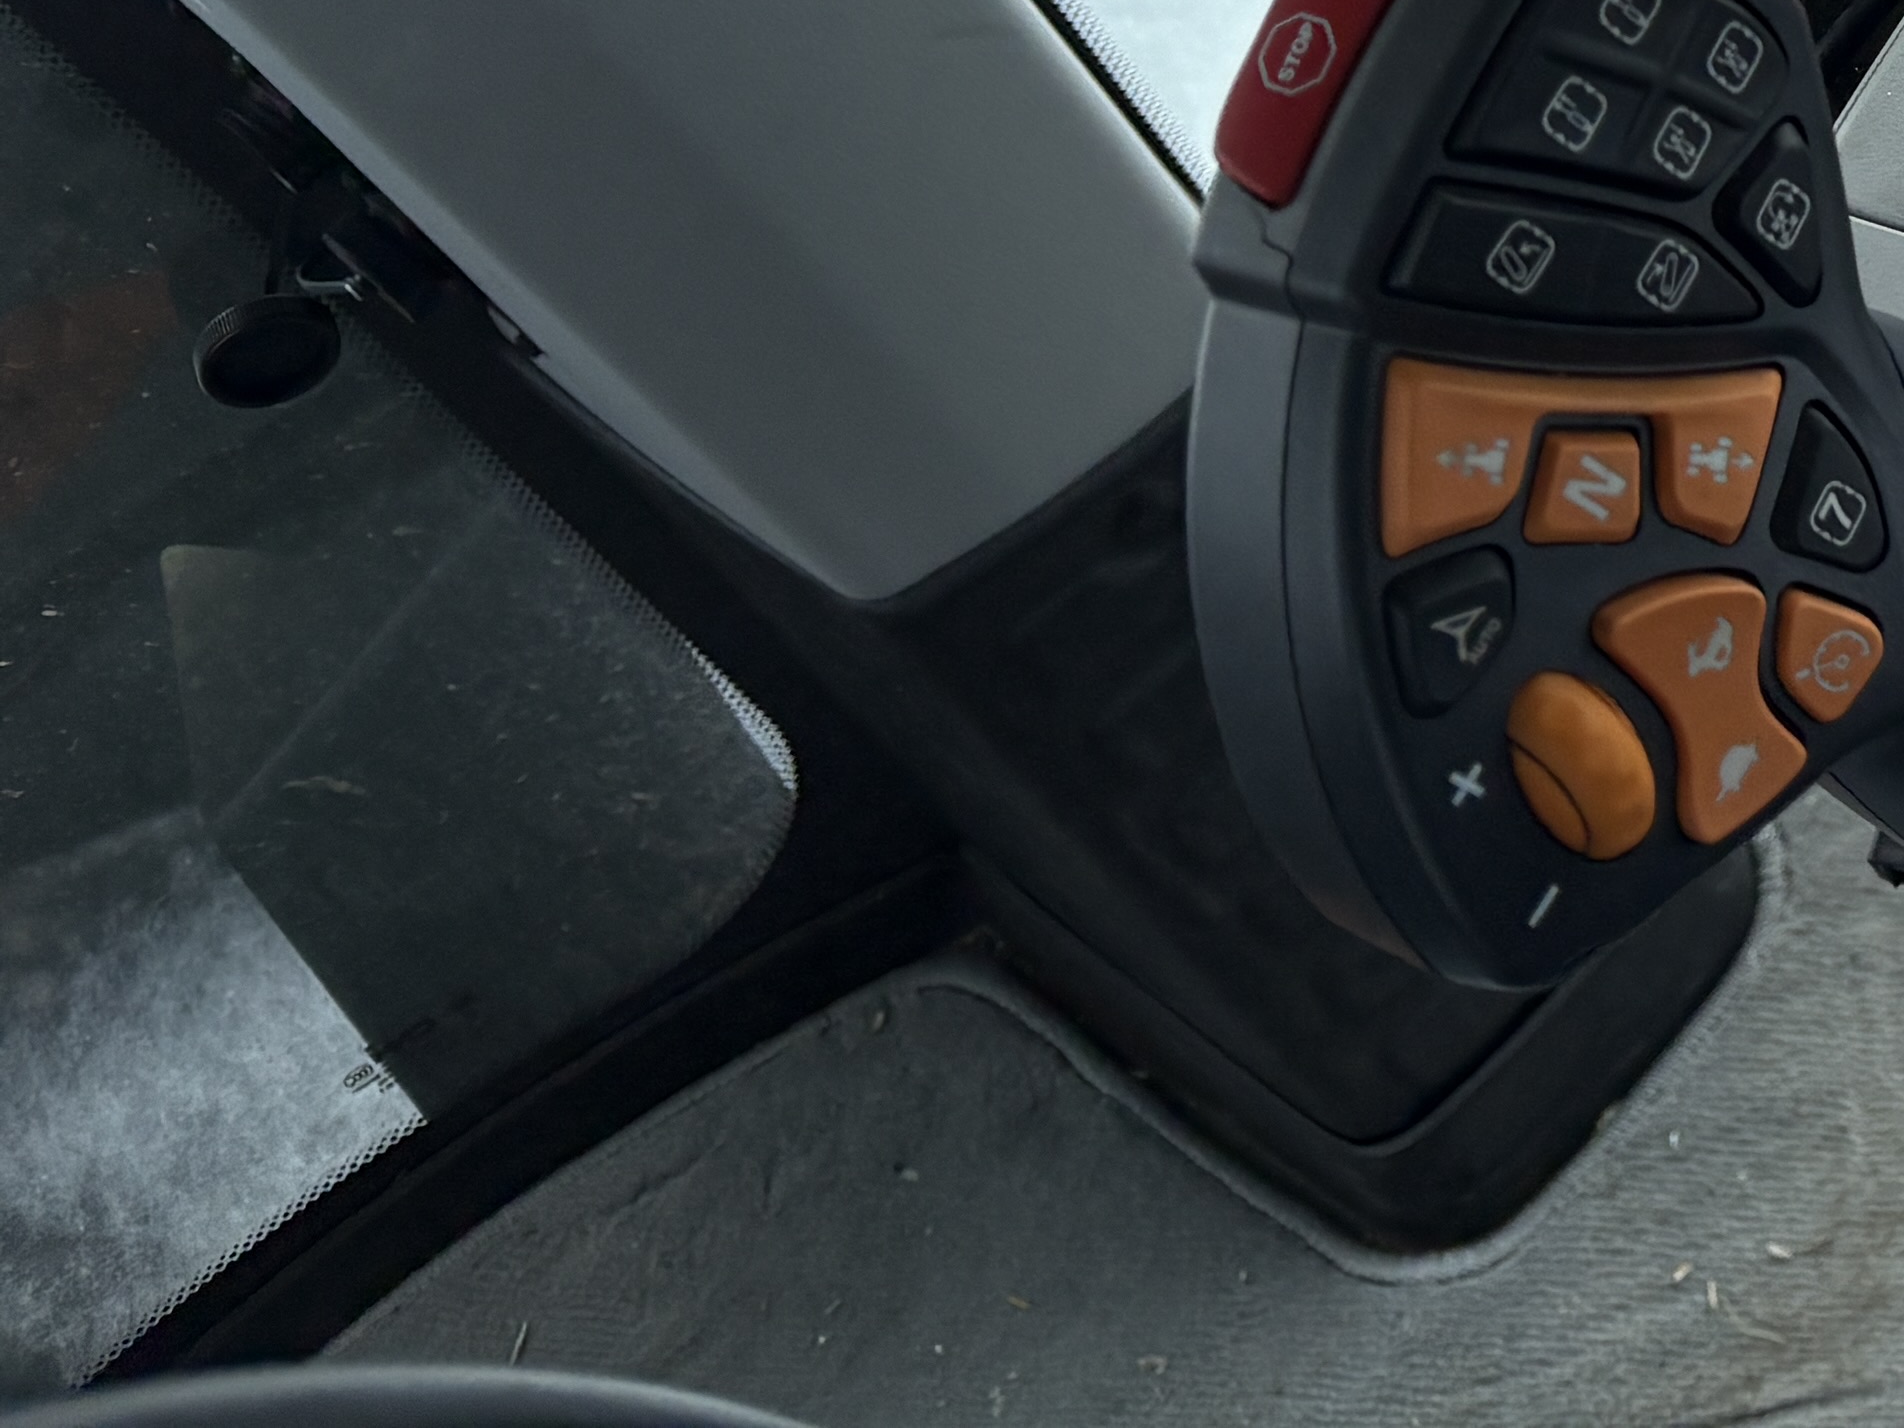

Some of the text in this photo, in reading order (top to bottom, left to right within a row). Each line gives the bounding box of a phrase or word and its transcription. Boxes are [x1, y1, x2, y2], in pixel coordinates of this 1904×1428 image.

[1278, 21, 1313, 81] STOP
[1563, 454, 1628, 523] N
[1818, 491, 1852, 531] 7
[1466, 617, 1502, 666] AUTO
